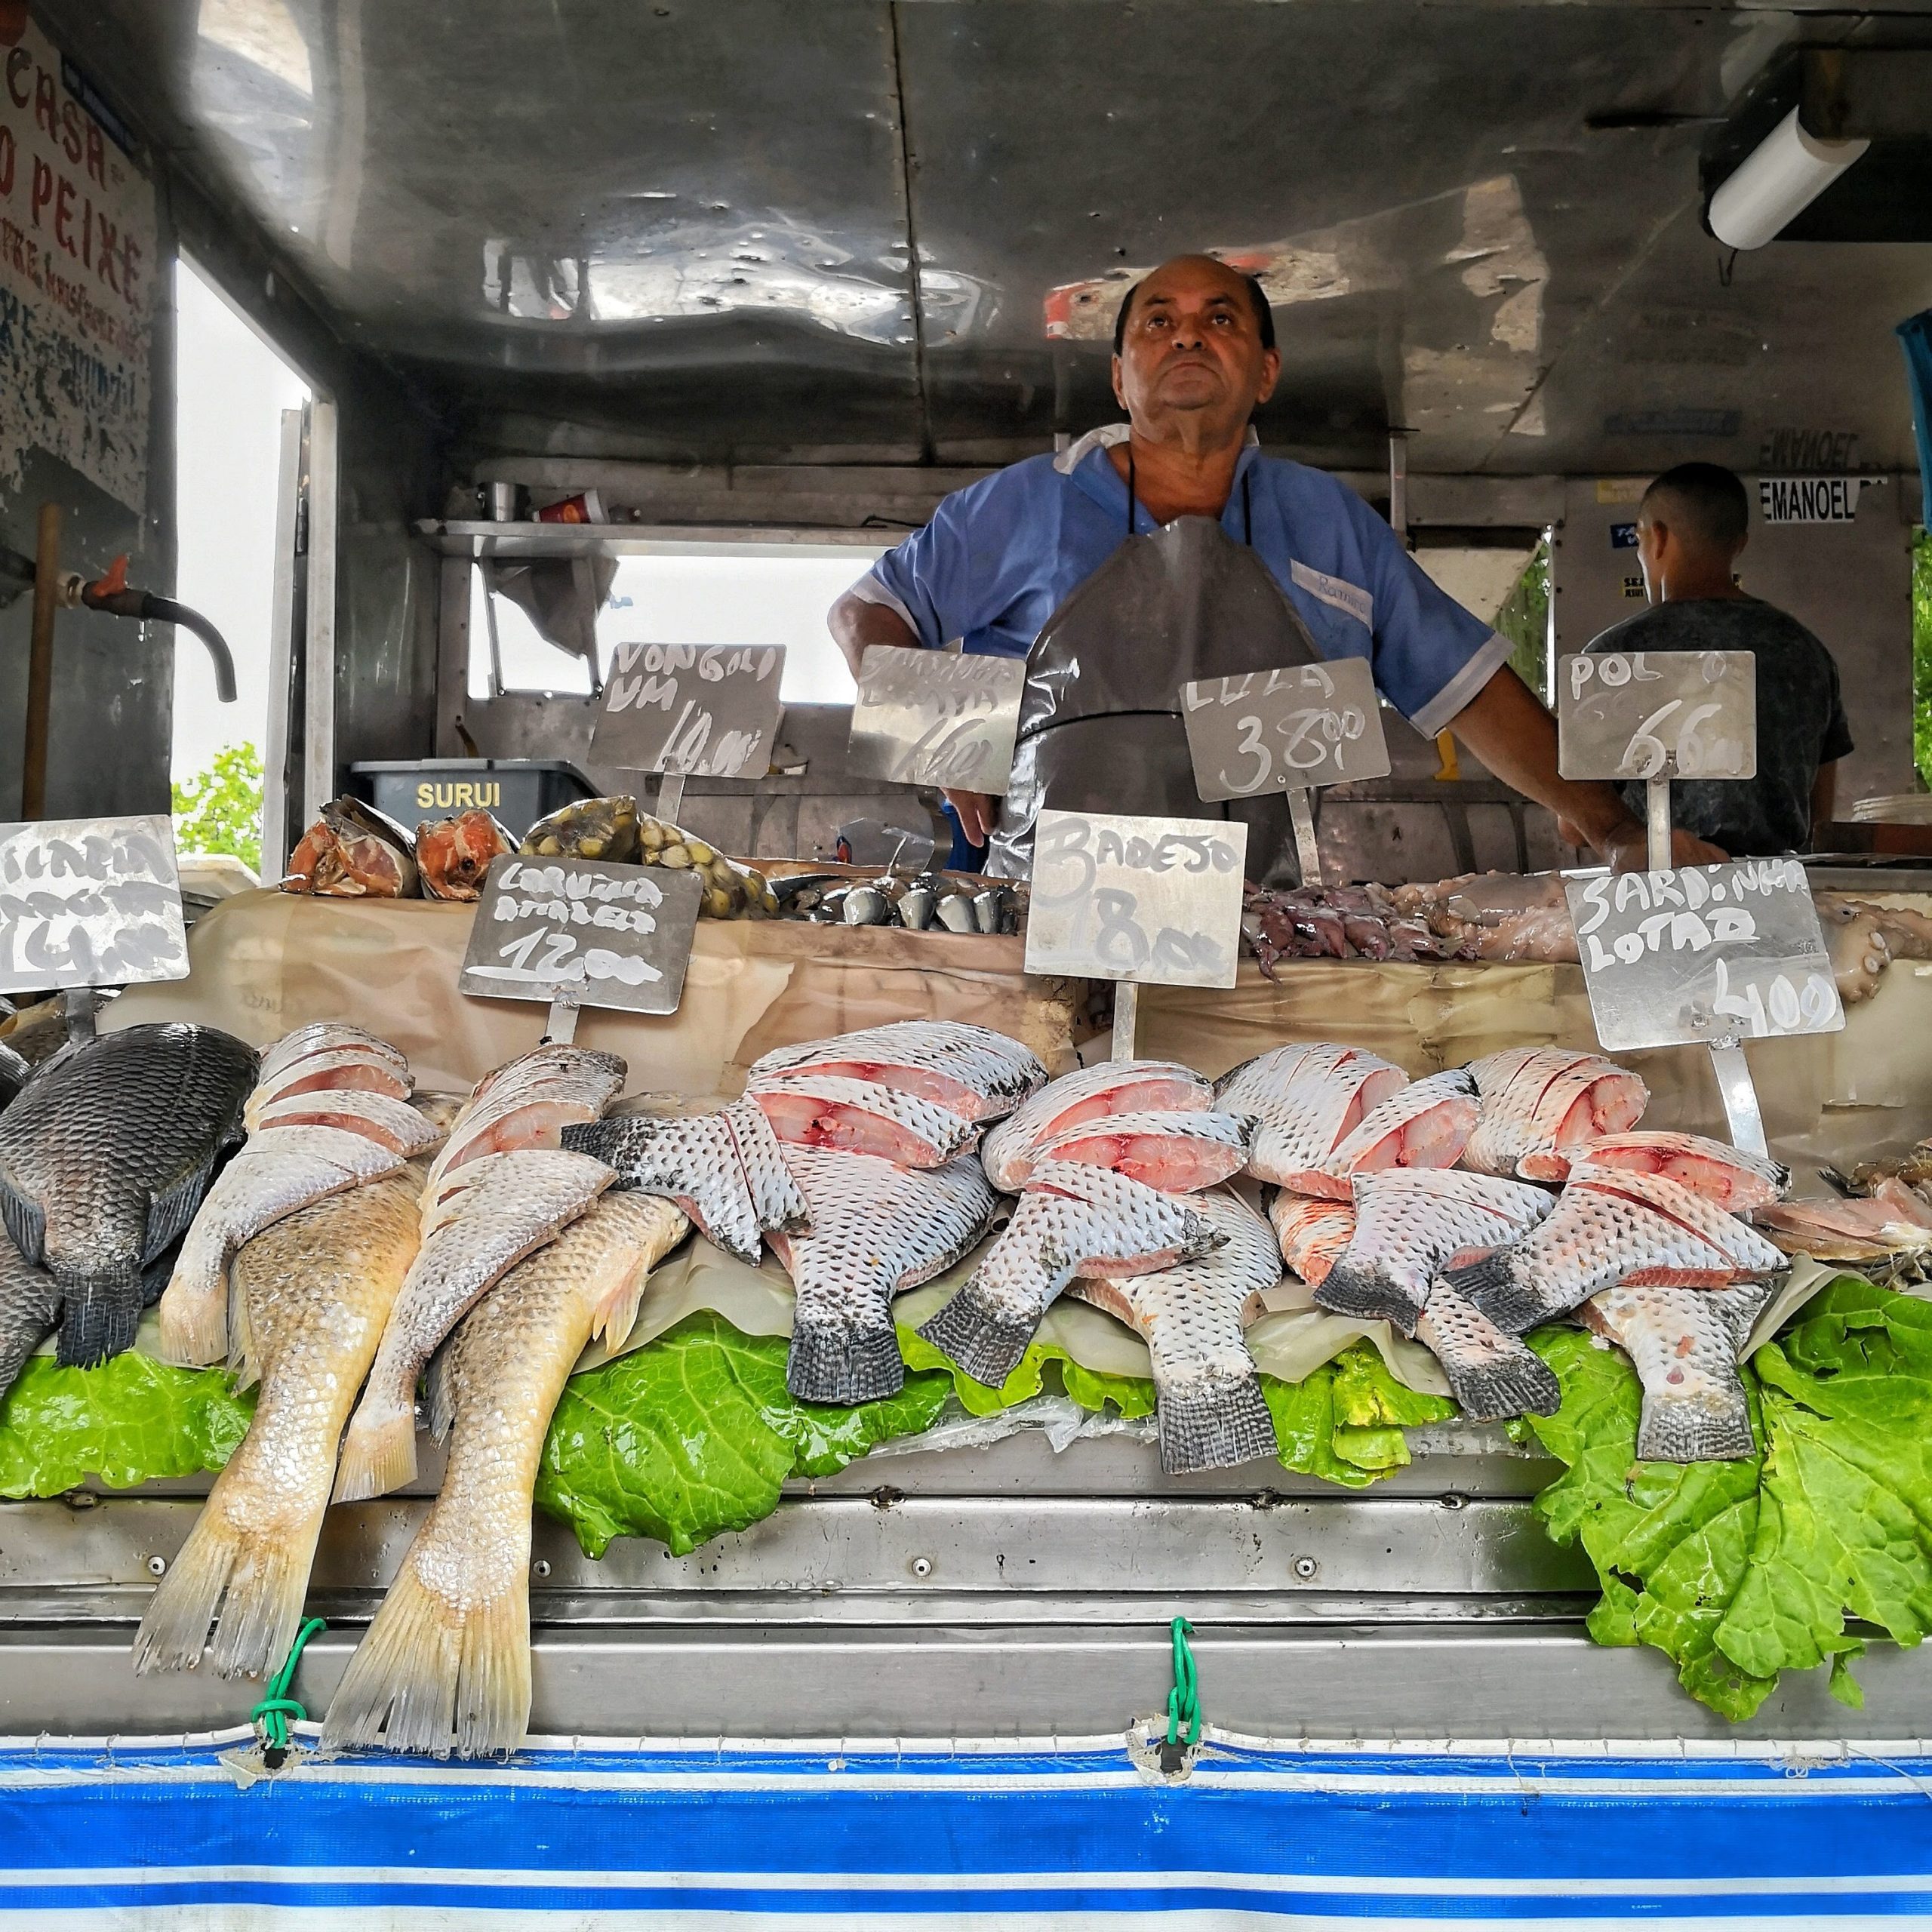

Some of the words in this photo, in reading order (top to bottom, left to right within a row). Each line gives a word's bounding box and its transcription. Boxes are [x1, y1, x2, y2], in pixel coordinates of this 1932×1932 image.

[6, 47, 107, 192] CASA
[31, 153, 144, 315] PEIXE
[1760, 480, 1855, 519] EMANOEL
[417, 782, 500, 808] SURUI
[1032, 817, 1240, 907] BADEJO
